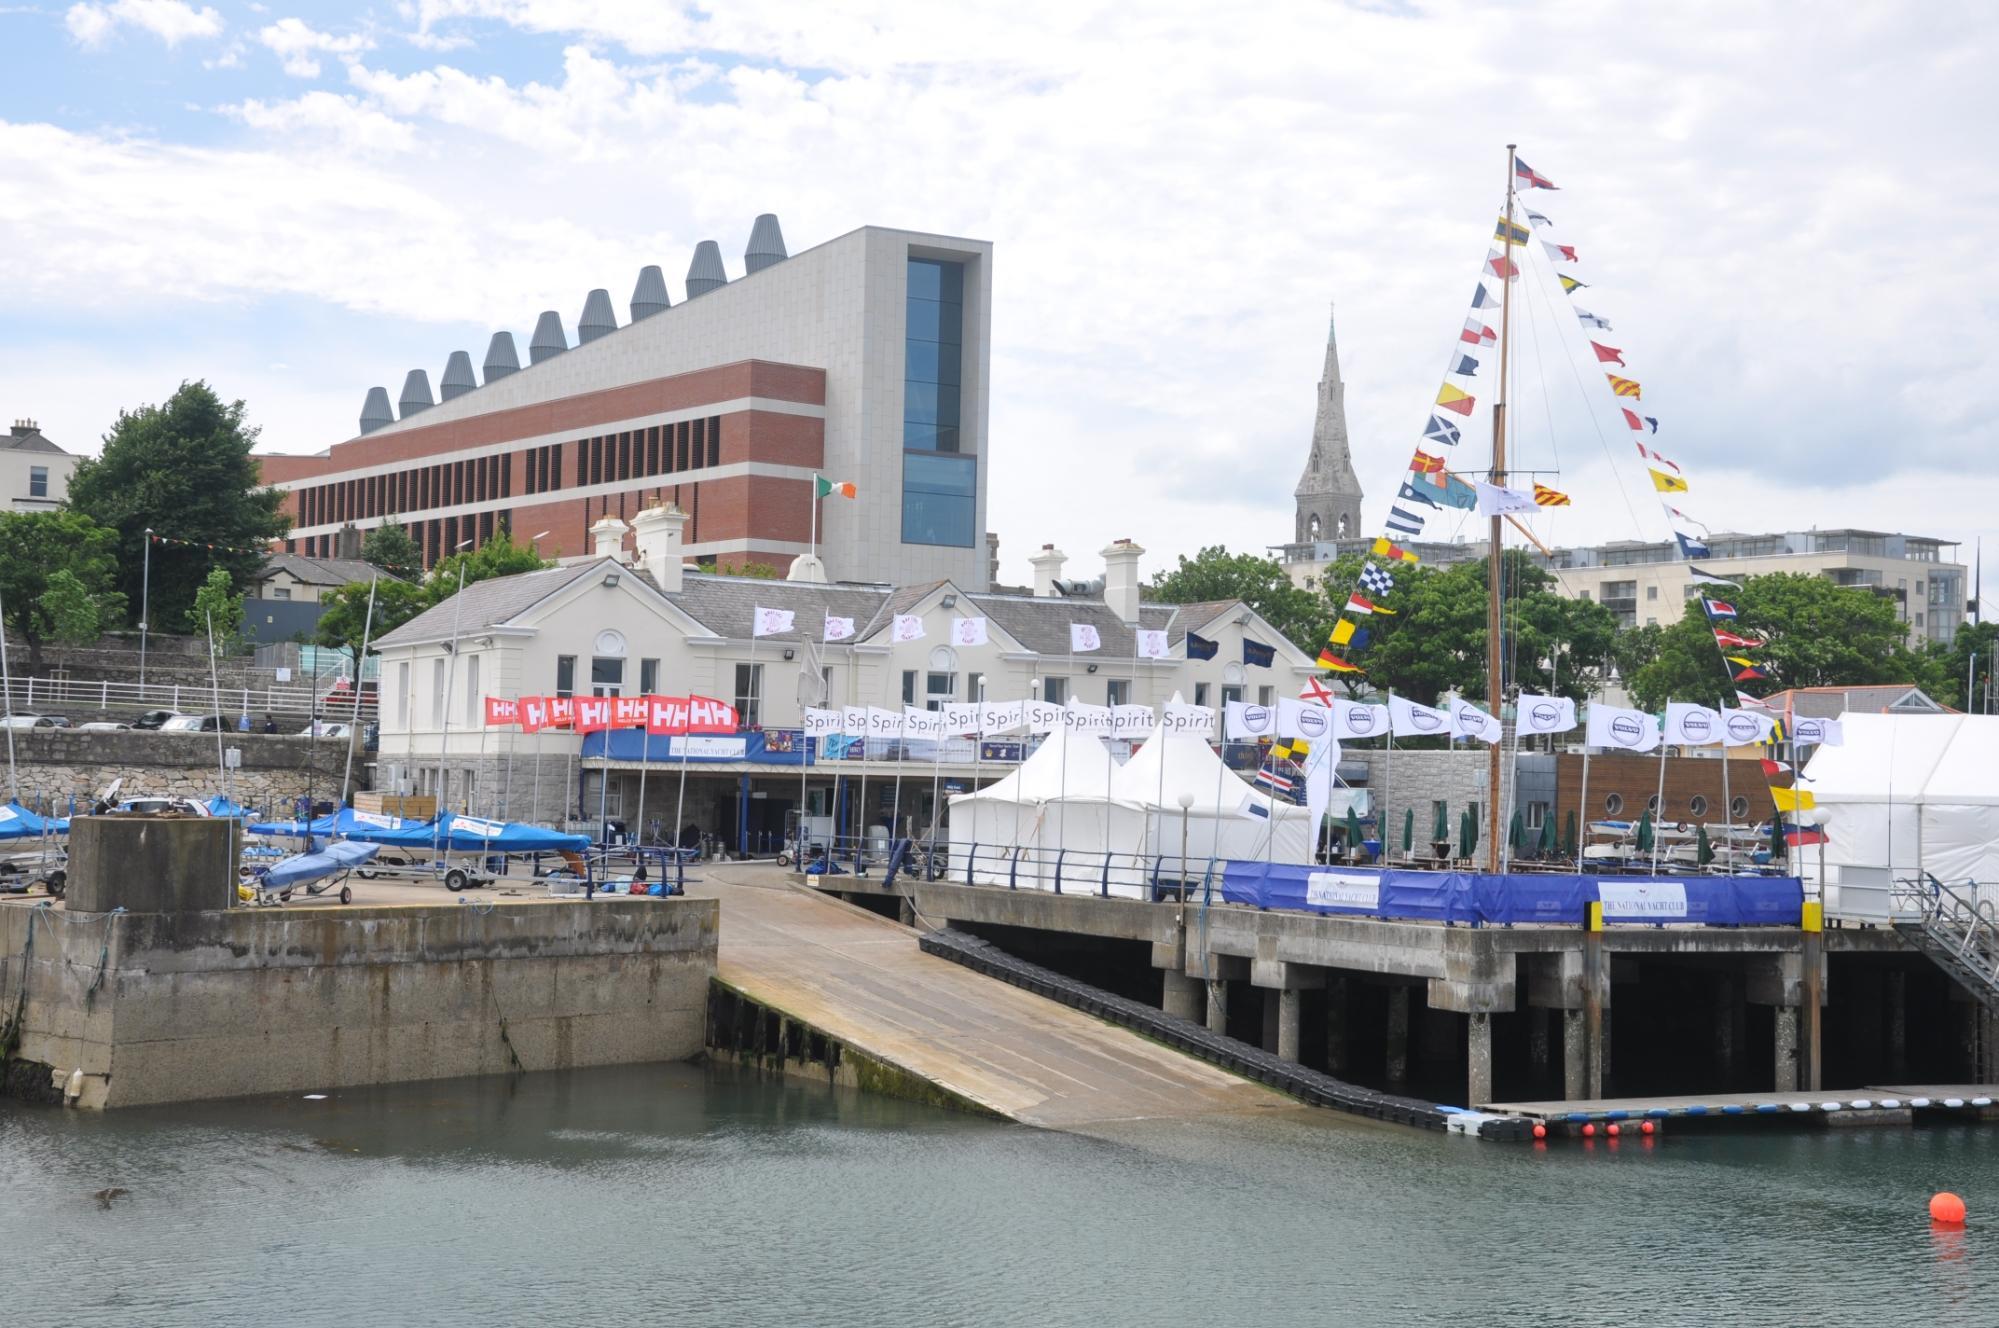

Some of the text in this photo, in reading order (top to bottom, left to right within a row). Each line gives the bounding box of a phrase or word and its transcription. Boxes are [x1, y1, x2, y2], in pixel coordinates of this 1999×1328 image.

[691, 700, 732, 726] HH
[1163, 711, 1214, 732] Spirit
[1614, 724, 1639, 733] VOLVO
[1604, 901, 1685, 911] THE NATIONAL YACHT CLUB
